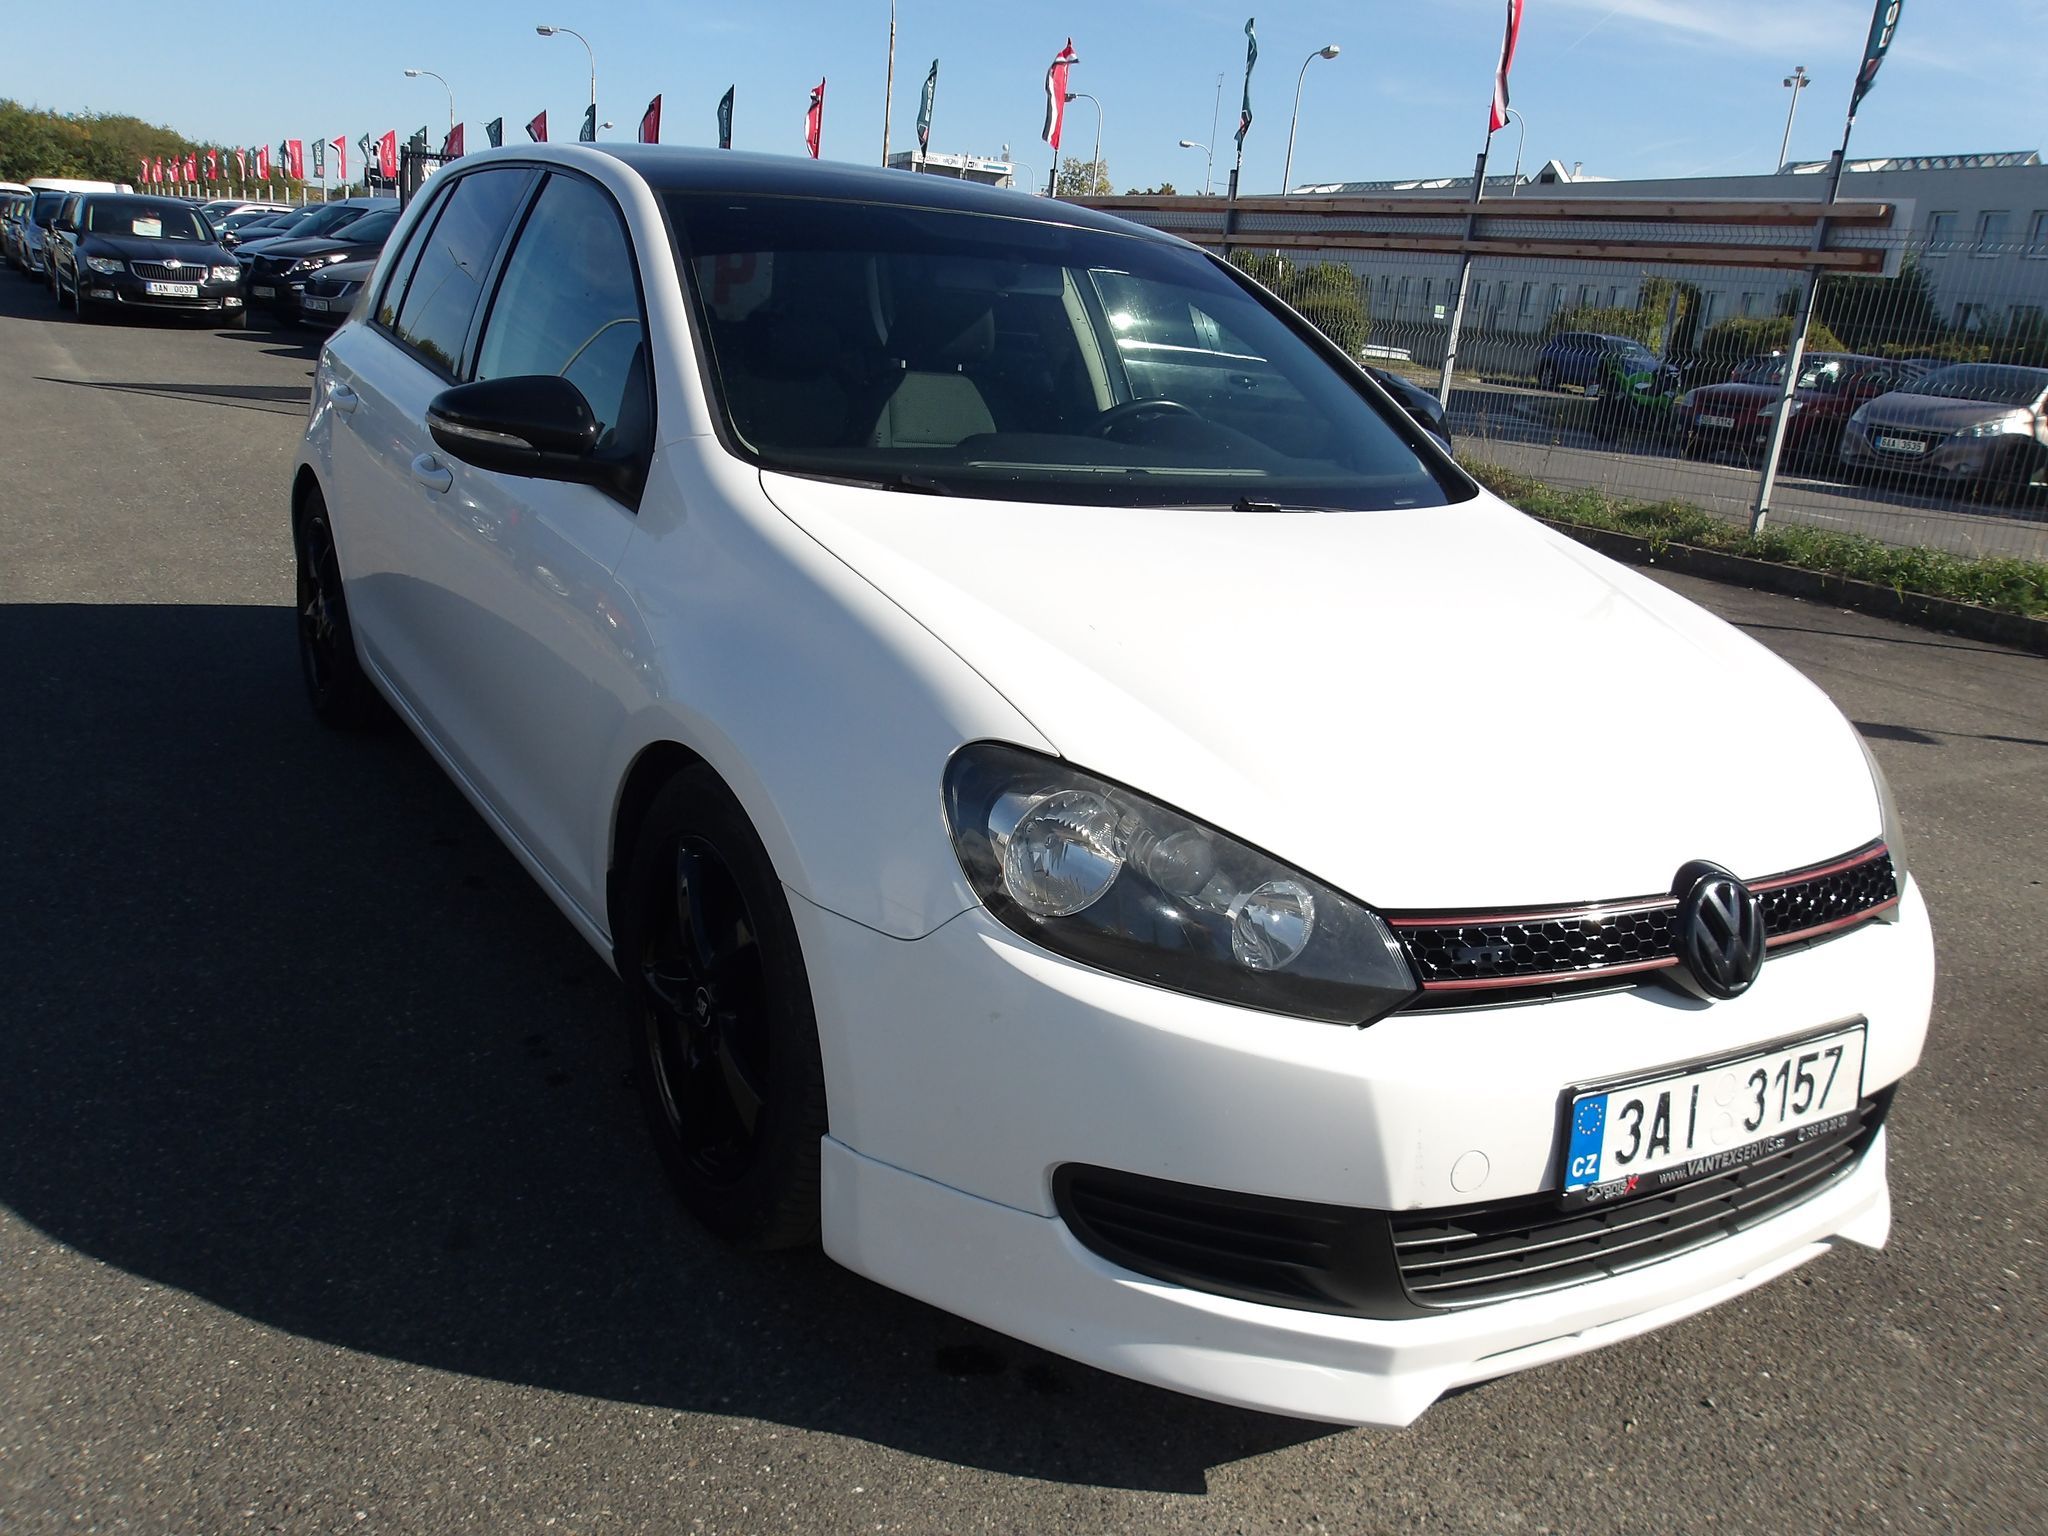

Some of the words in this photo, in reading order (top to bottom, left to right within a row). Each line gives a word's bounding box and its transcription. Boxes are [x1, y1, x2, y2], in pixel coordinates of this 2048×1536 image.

[153, 284, 169, 294] 1AN
[173, 285, 194, 295] 0037
[1615, 1084, 1699, 1165] 3AI
[1744, 1045, 1844, 1132] 3157
[1571, 1153, 1598, 1178] CZ
